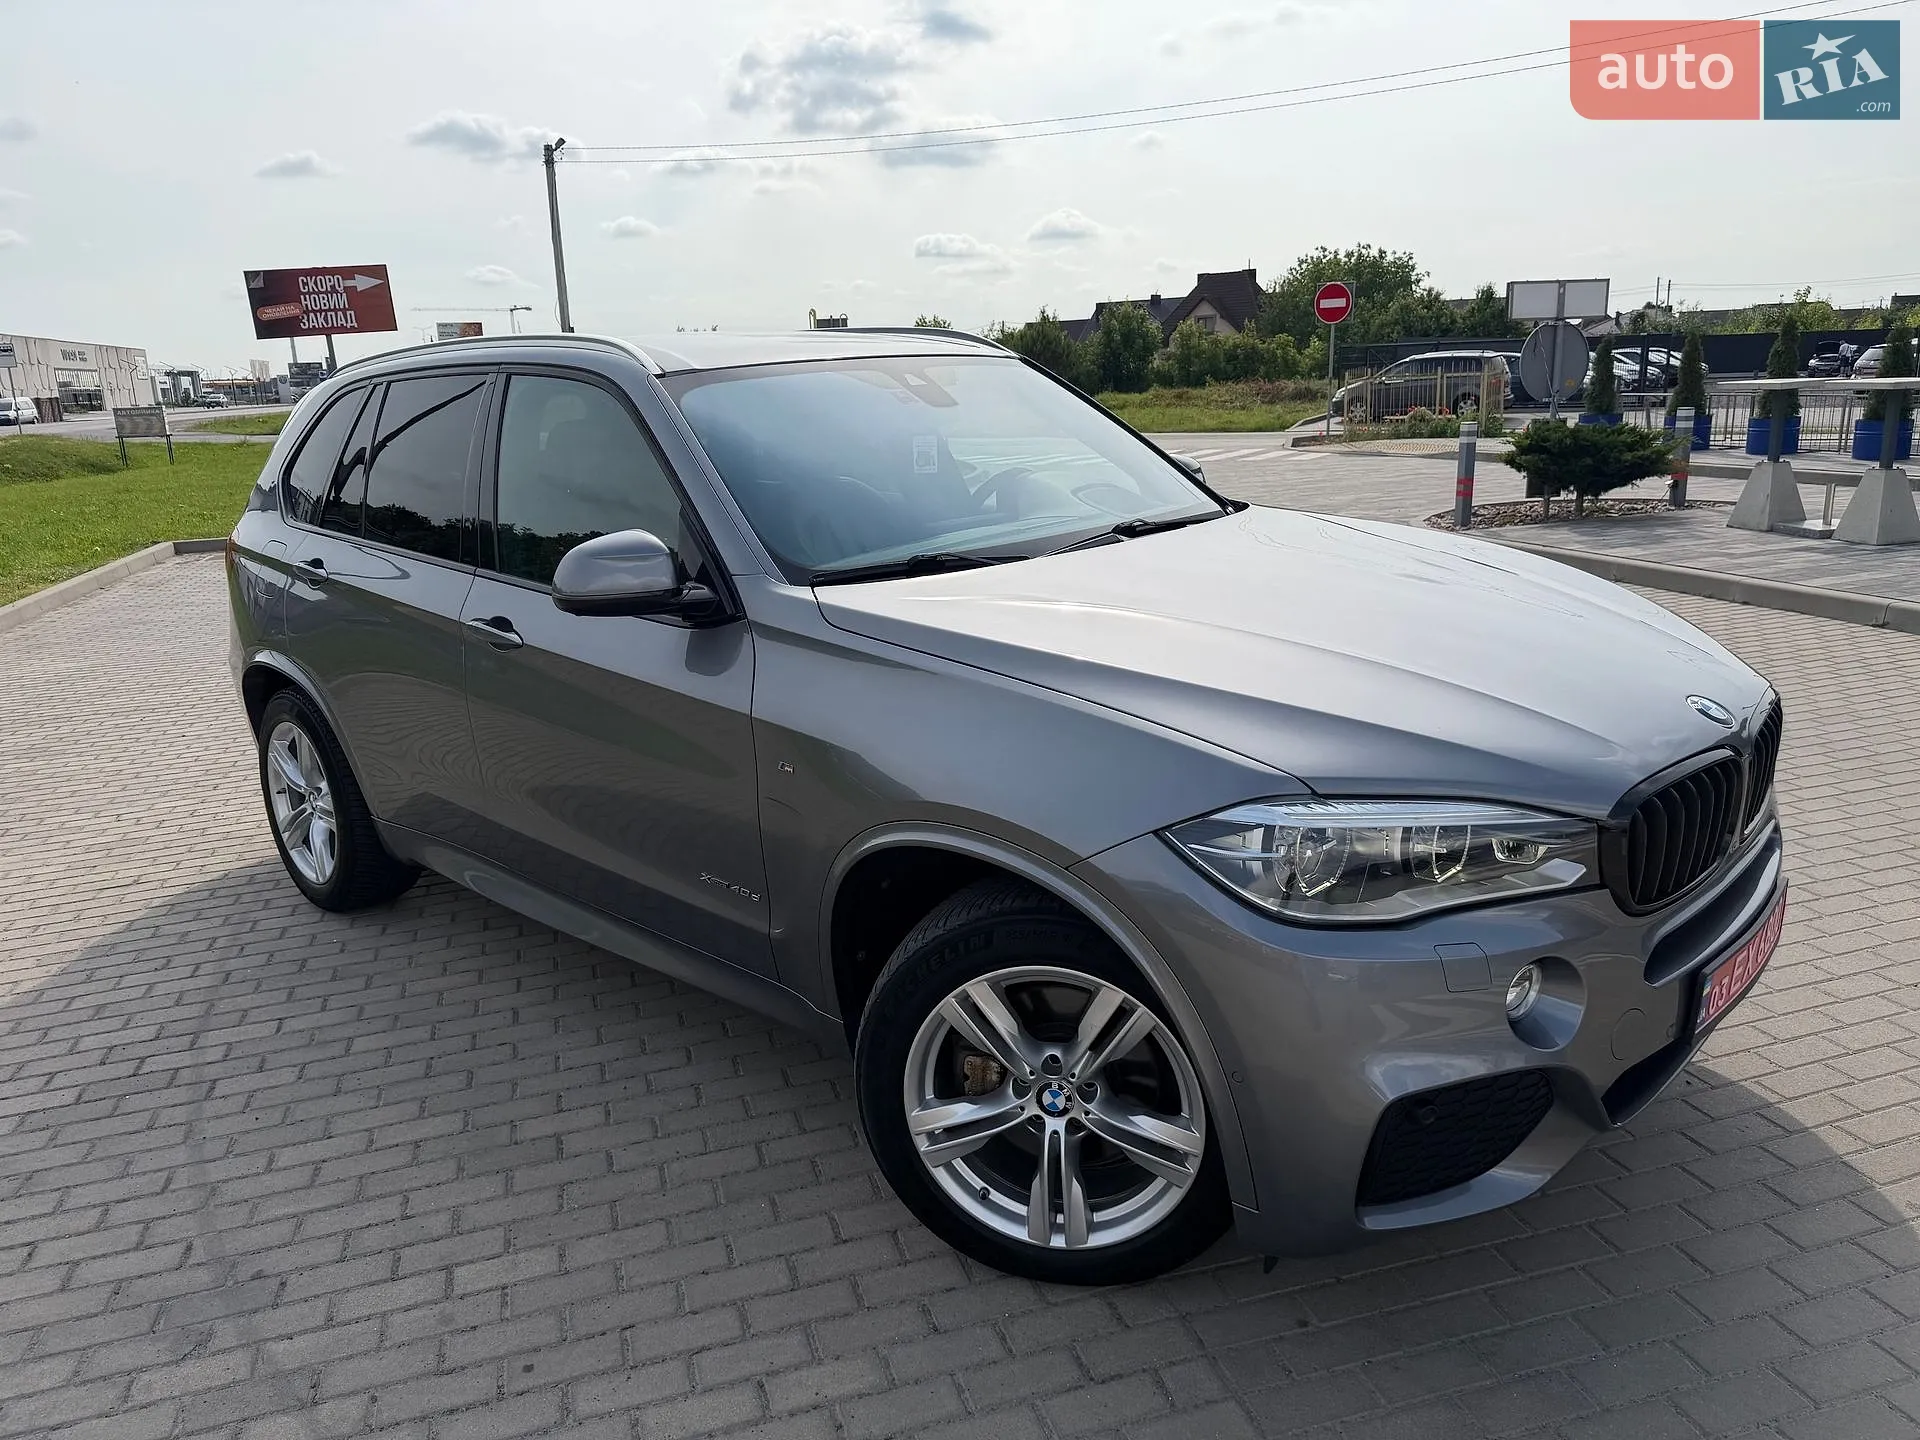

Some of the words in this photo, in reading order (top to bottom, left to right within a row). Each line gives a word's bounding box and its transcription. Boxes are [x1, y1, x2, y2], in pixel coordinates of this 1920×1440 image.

[298, 275, 344, 292] СКОРО
[300, 290, 348, 311] НОВИЙ
[299, 310, 357, 329] ЗАКЛАД
